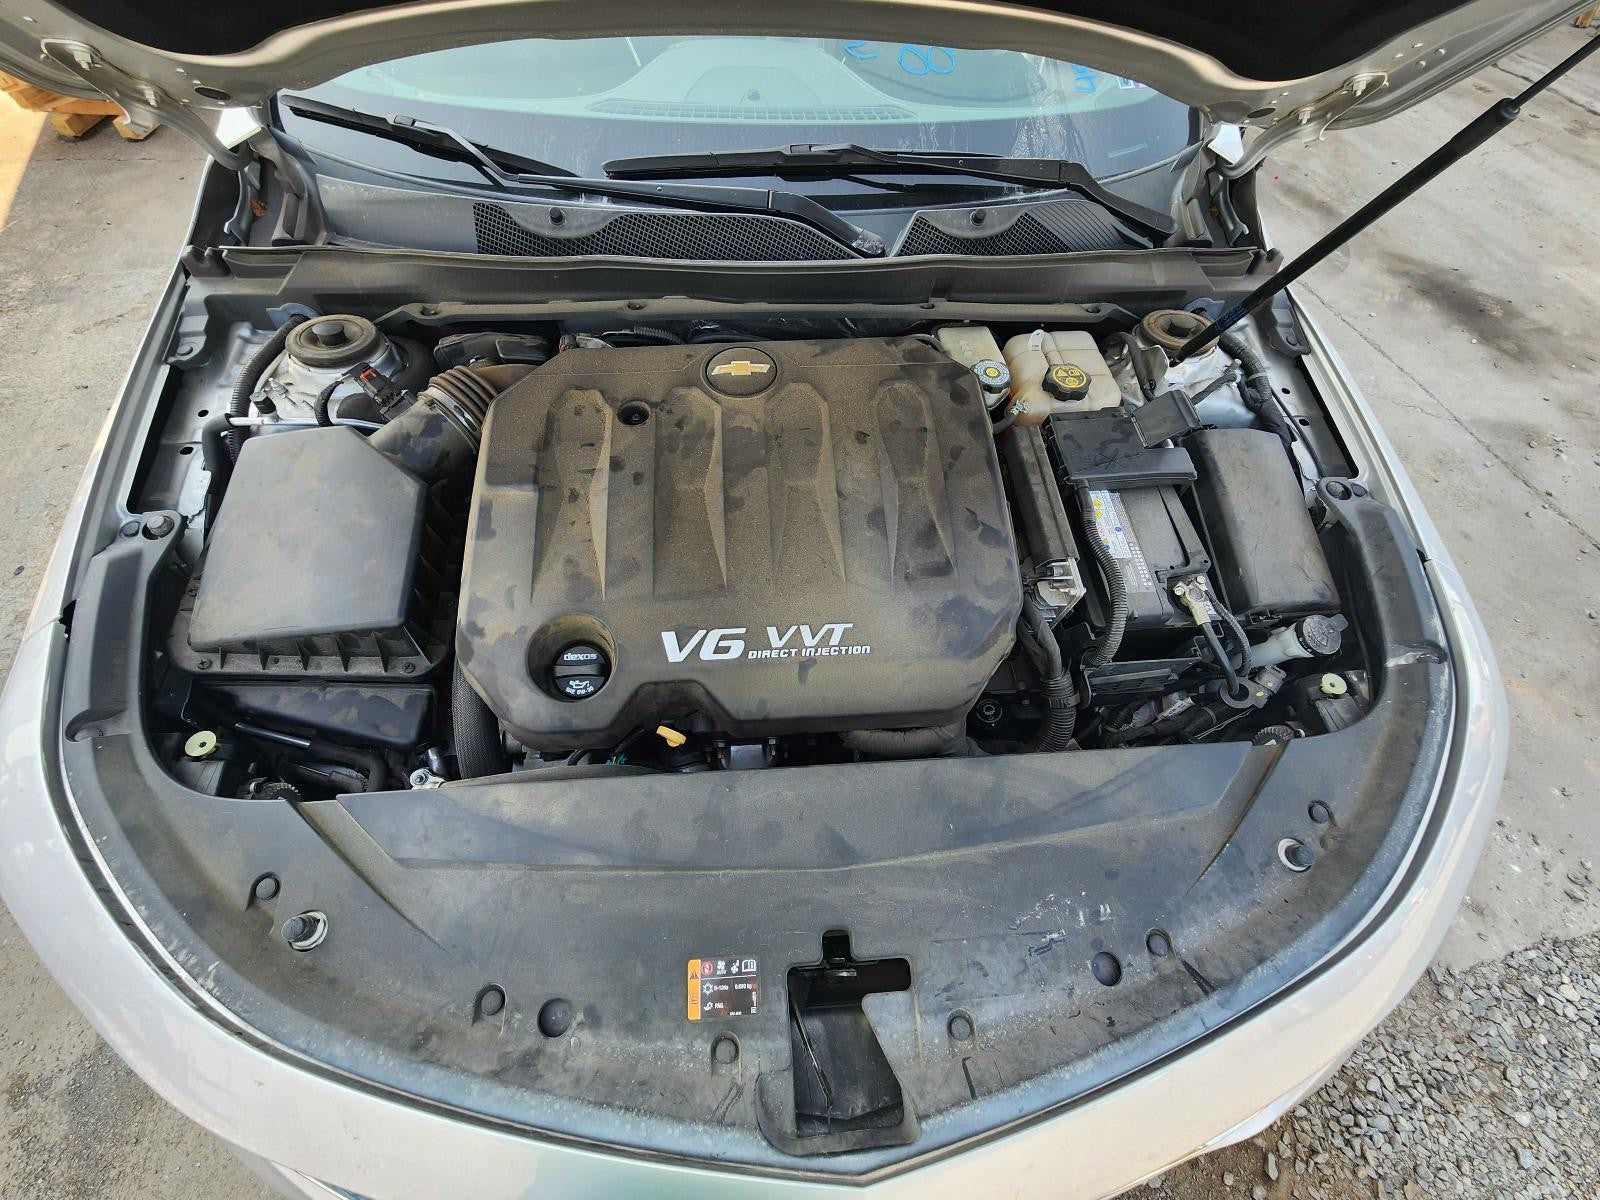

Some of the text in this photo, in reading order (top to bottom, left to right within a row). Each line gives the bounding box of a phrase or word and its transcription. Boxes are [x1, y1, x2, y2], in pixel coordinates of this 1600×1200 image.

[661, 623, 854, 663] V6 VVT
[563, 652, 598, 661] dexos
[748, 645, 871, 660] DIRECT INJECTION
